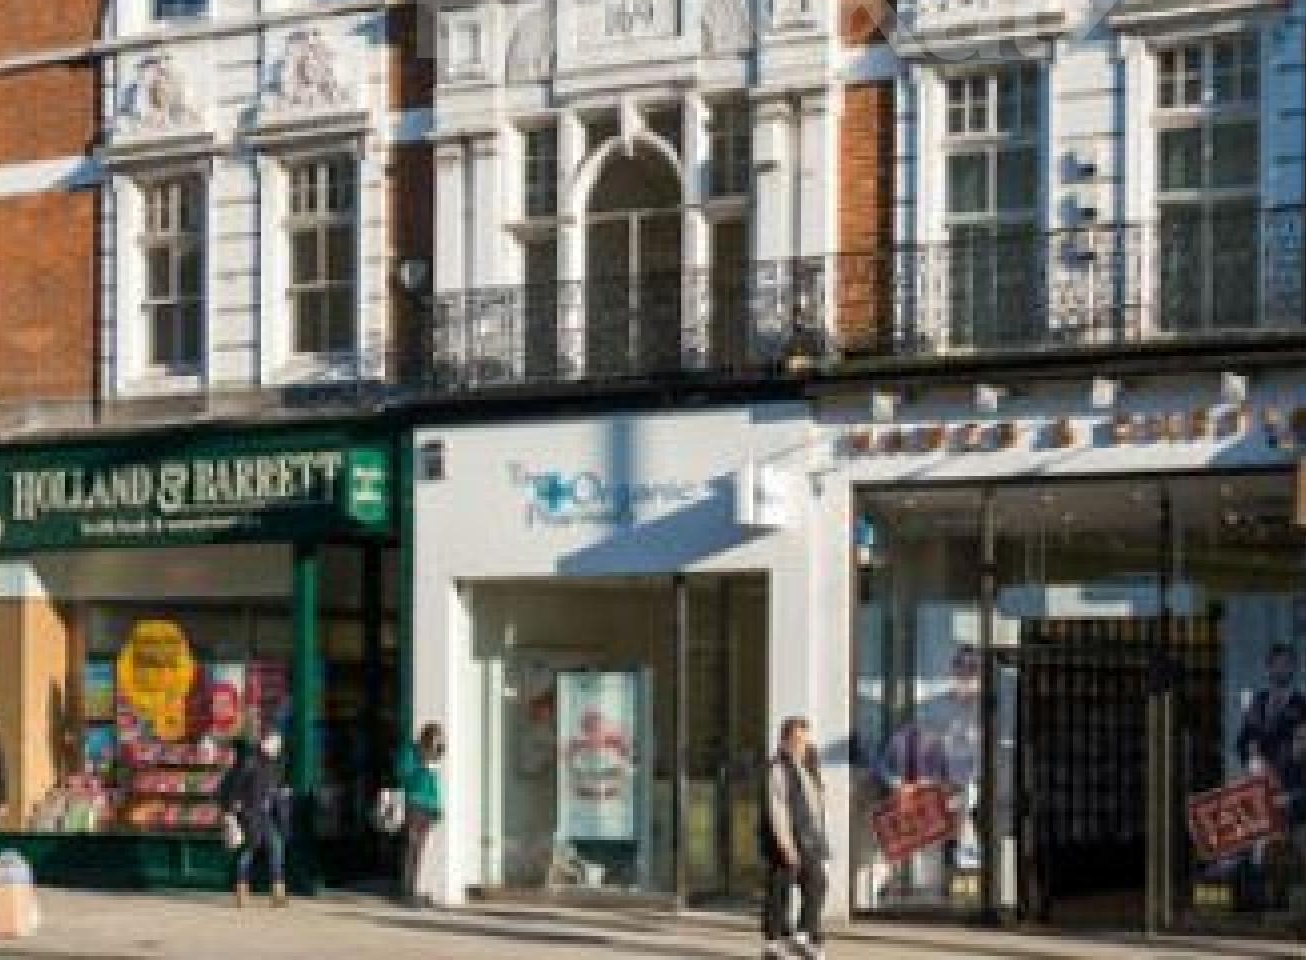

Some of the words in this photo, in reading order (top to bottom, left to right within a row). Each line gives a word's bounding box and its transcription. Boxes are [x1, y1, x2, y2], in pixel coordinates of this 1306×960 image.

[12, 464, 152, 520] HOLLAND
[157, 460, 190, 512] &
[192, 451, 342, 502] BARRETT
